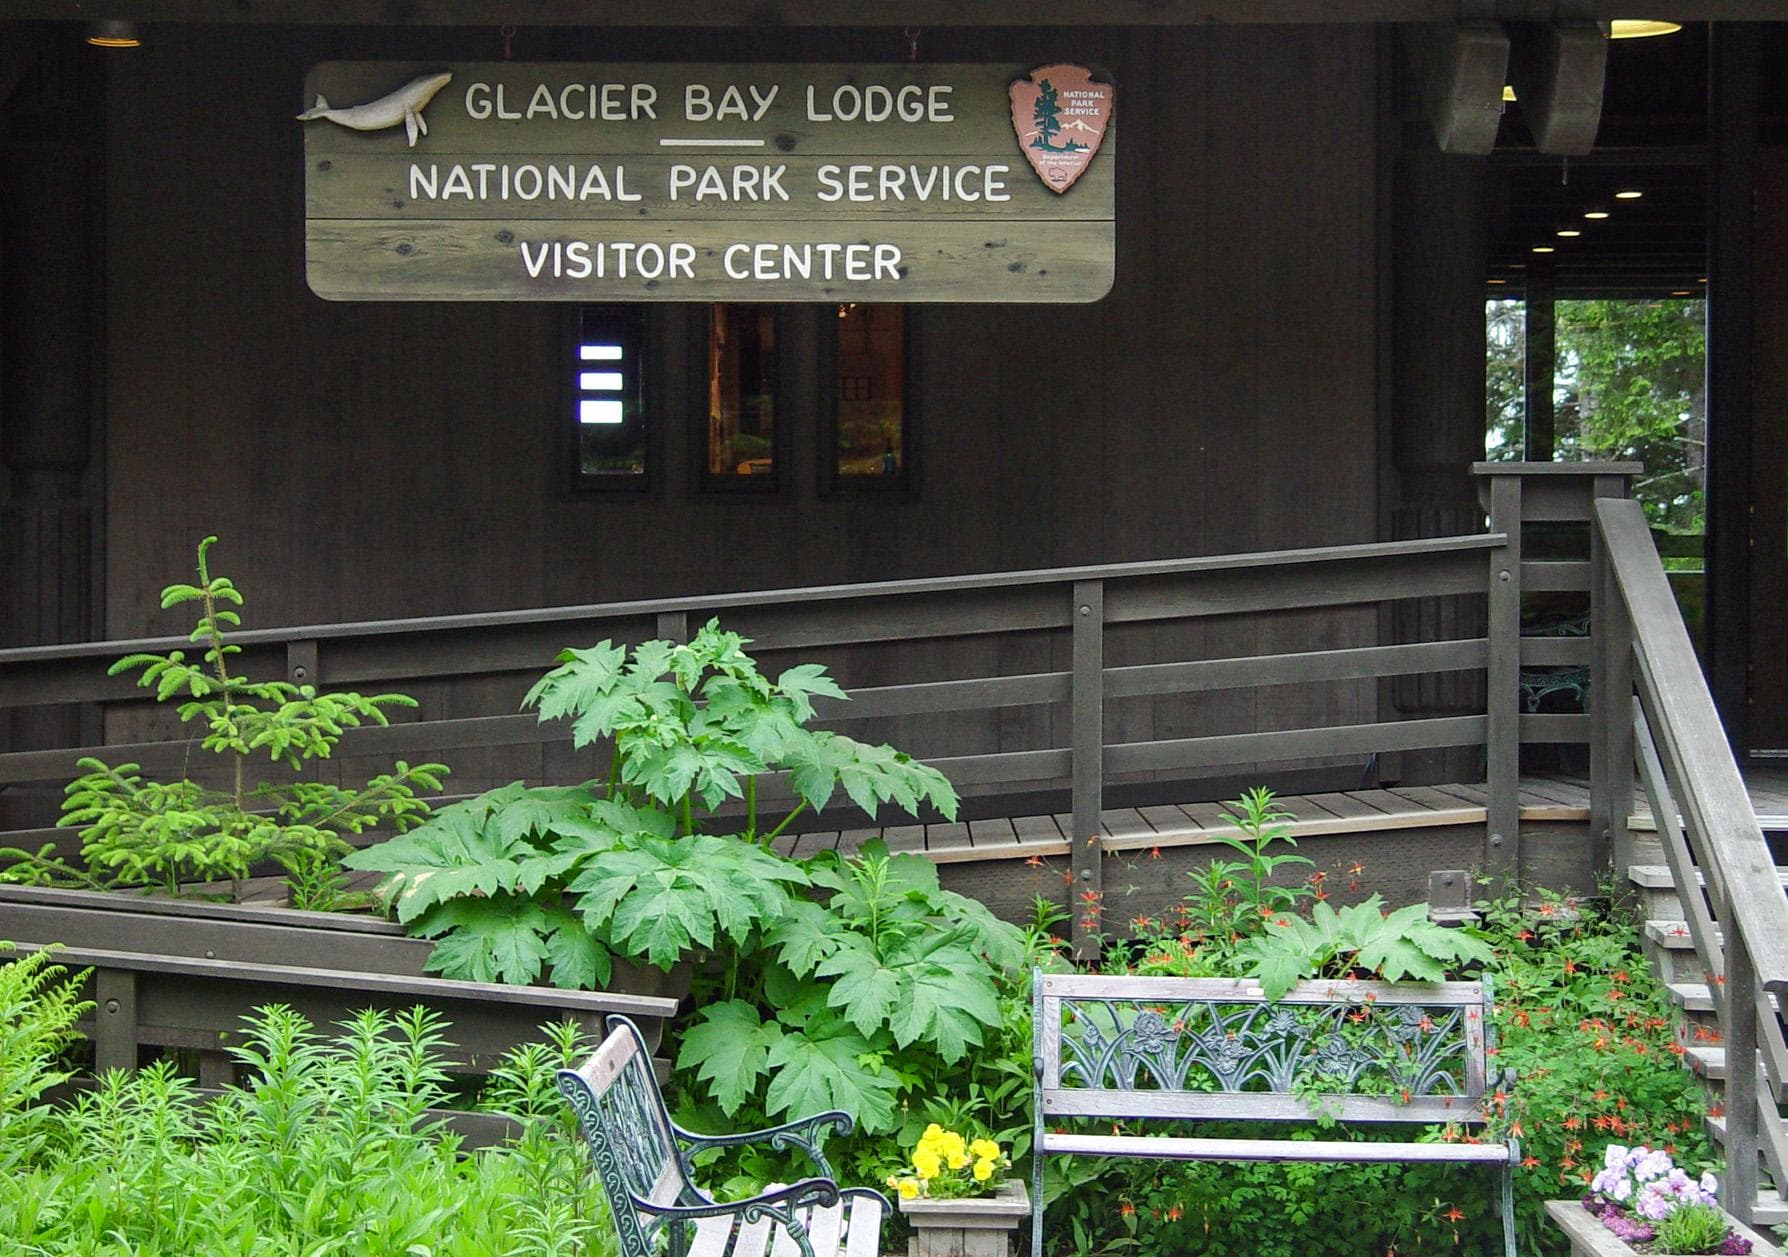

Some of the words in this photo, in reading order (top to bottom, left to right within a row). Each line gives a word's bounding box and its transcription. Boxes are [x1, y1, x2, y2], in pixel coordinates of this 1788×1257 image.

[464, 83, 658, 121] GLACIER
[684, 84, 780, 122] BAY
[806, 85, 954, 123] LODGE
[1063, 91, 1104, 99] NATIONAL
[1063, 108, 1100, 116] SERVICE
[409, 163, 642, 203] NATIONAL
[669, 164, 790, 203] PARK
[816, 164, 1012, 203] SERVICE
[520, 241, 697, 281] VISITOR
[723, 242, 903, 283] CENTER
